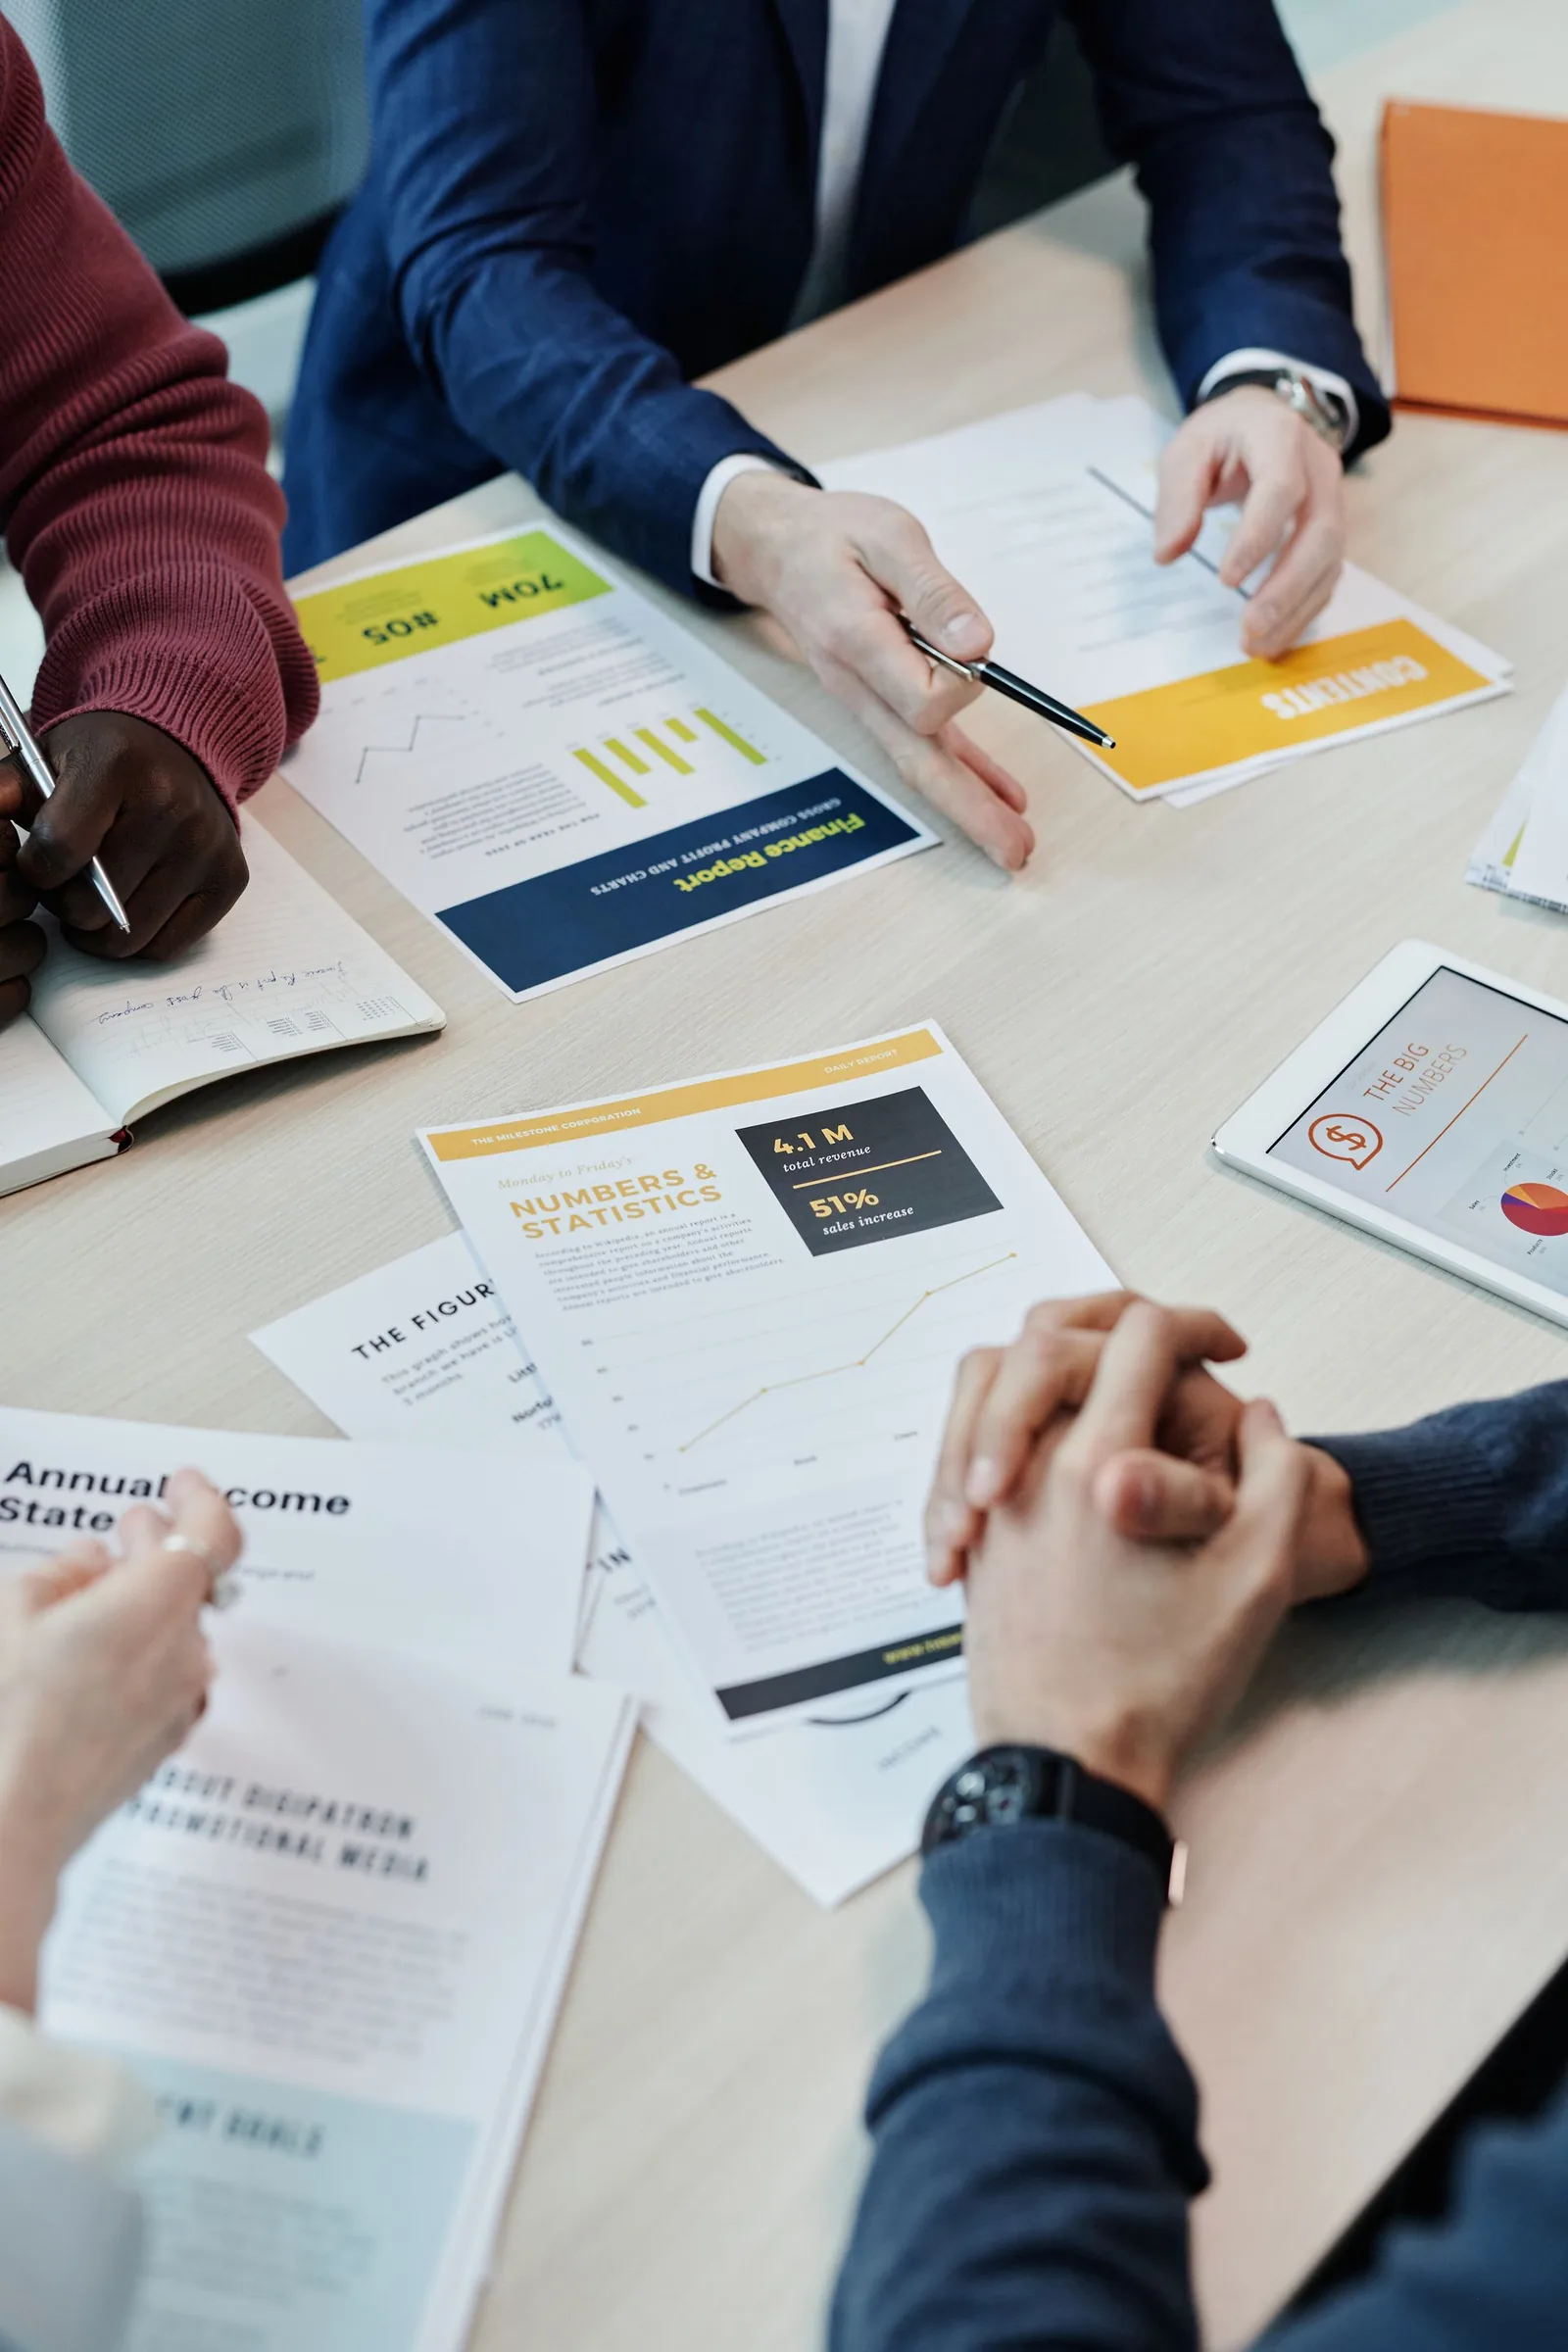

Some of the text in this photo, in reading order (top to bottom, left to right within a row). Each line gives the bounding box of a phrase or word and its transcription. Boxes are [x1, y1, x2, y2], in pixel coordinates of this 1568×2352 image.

[479, 572, 564, 609] 70M
[363, 610, 438, 646] #05
[1261, 655, 1428, 720] CONTENTS
[590, 797, 843, 896] GROSS COMPANY PROFIT AND CHARTS
[673, 812, 866, 893] Finance Report
[824, 1049, 899, 1074] DAILY REPORT
[1362, 1043, 1429, 1101] THE BIG
[1392, 1044, 1467, 1116] NUMBERS
[471, 1107, 642, 1147] THE MILESTONE CORPORATION
[773, 1124, 855, 1155] 4.1 M
[498, 1155, 633, 1191] Monday to Friday's
[783, 1145, 872, 1173] total revenue
[509, 1162, 718, 1219] NUMBERS &
[809, 1189, 880, 1219] 51%
[521, 1185, 722, 1240] STATISTICS
[822, 1205, 914, 1235] sales increase
[352, 1277, 497, 1363] THE FIGUR
[5, 1461, 351, 1516] Annual come
[0, 1496, 115, 1532] State
[152, 1765, 235, 1804] BOUT
